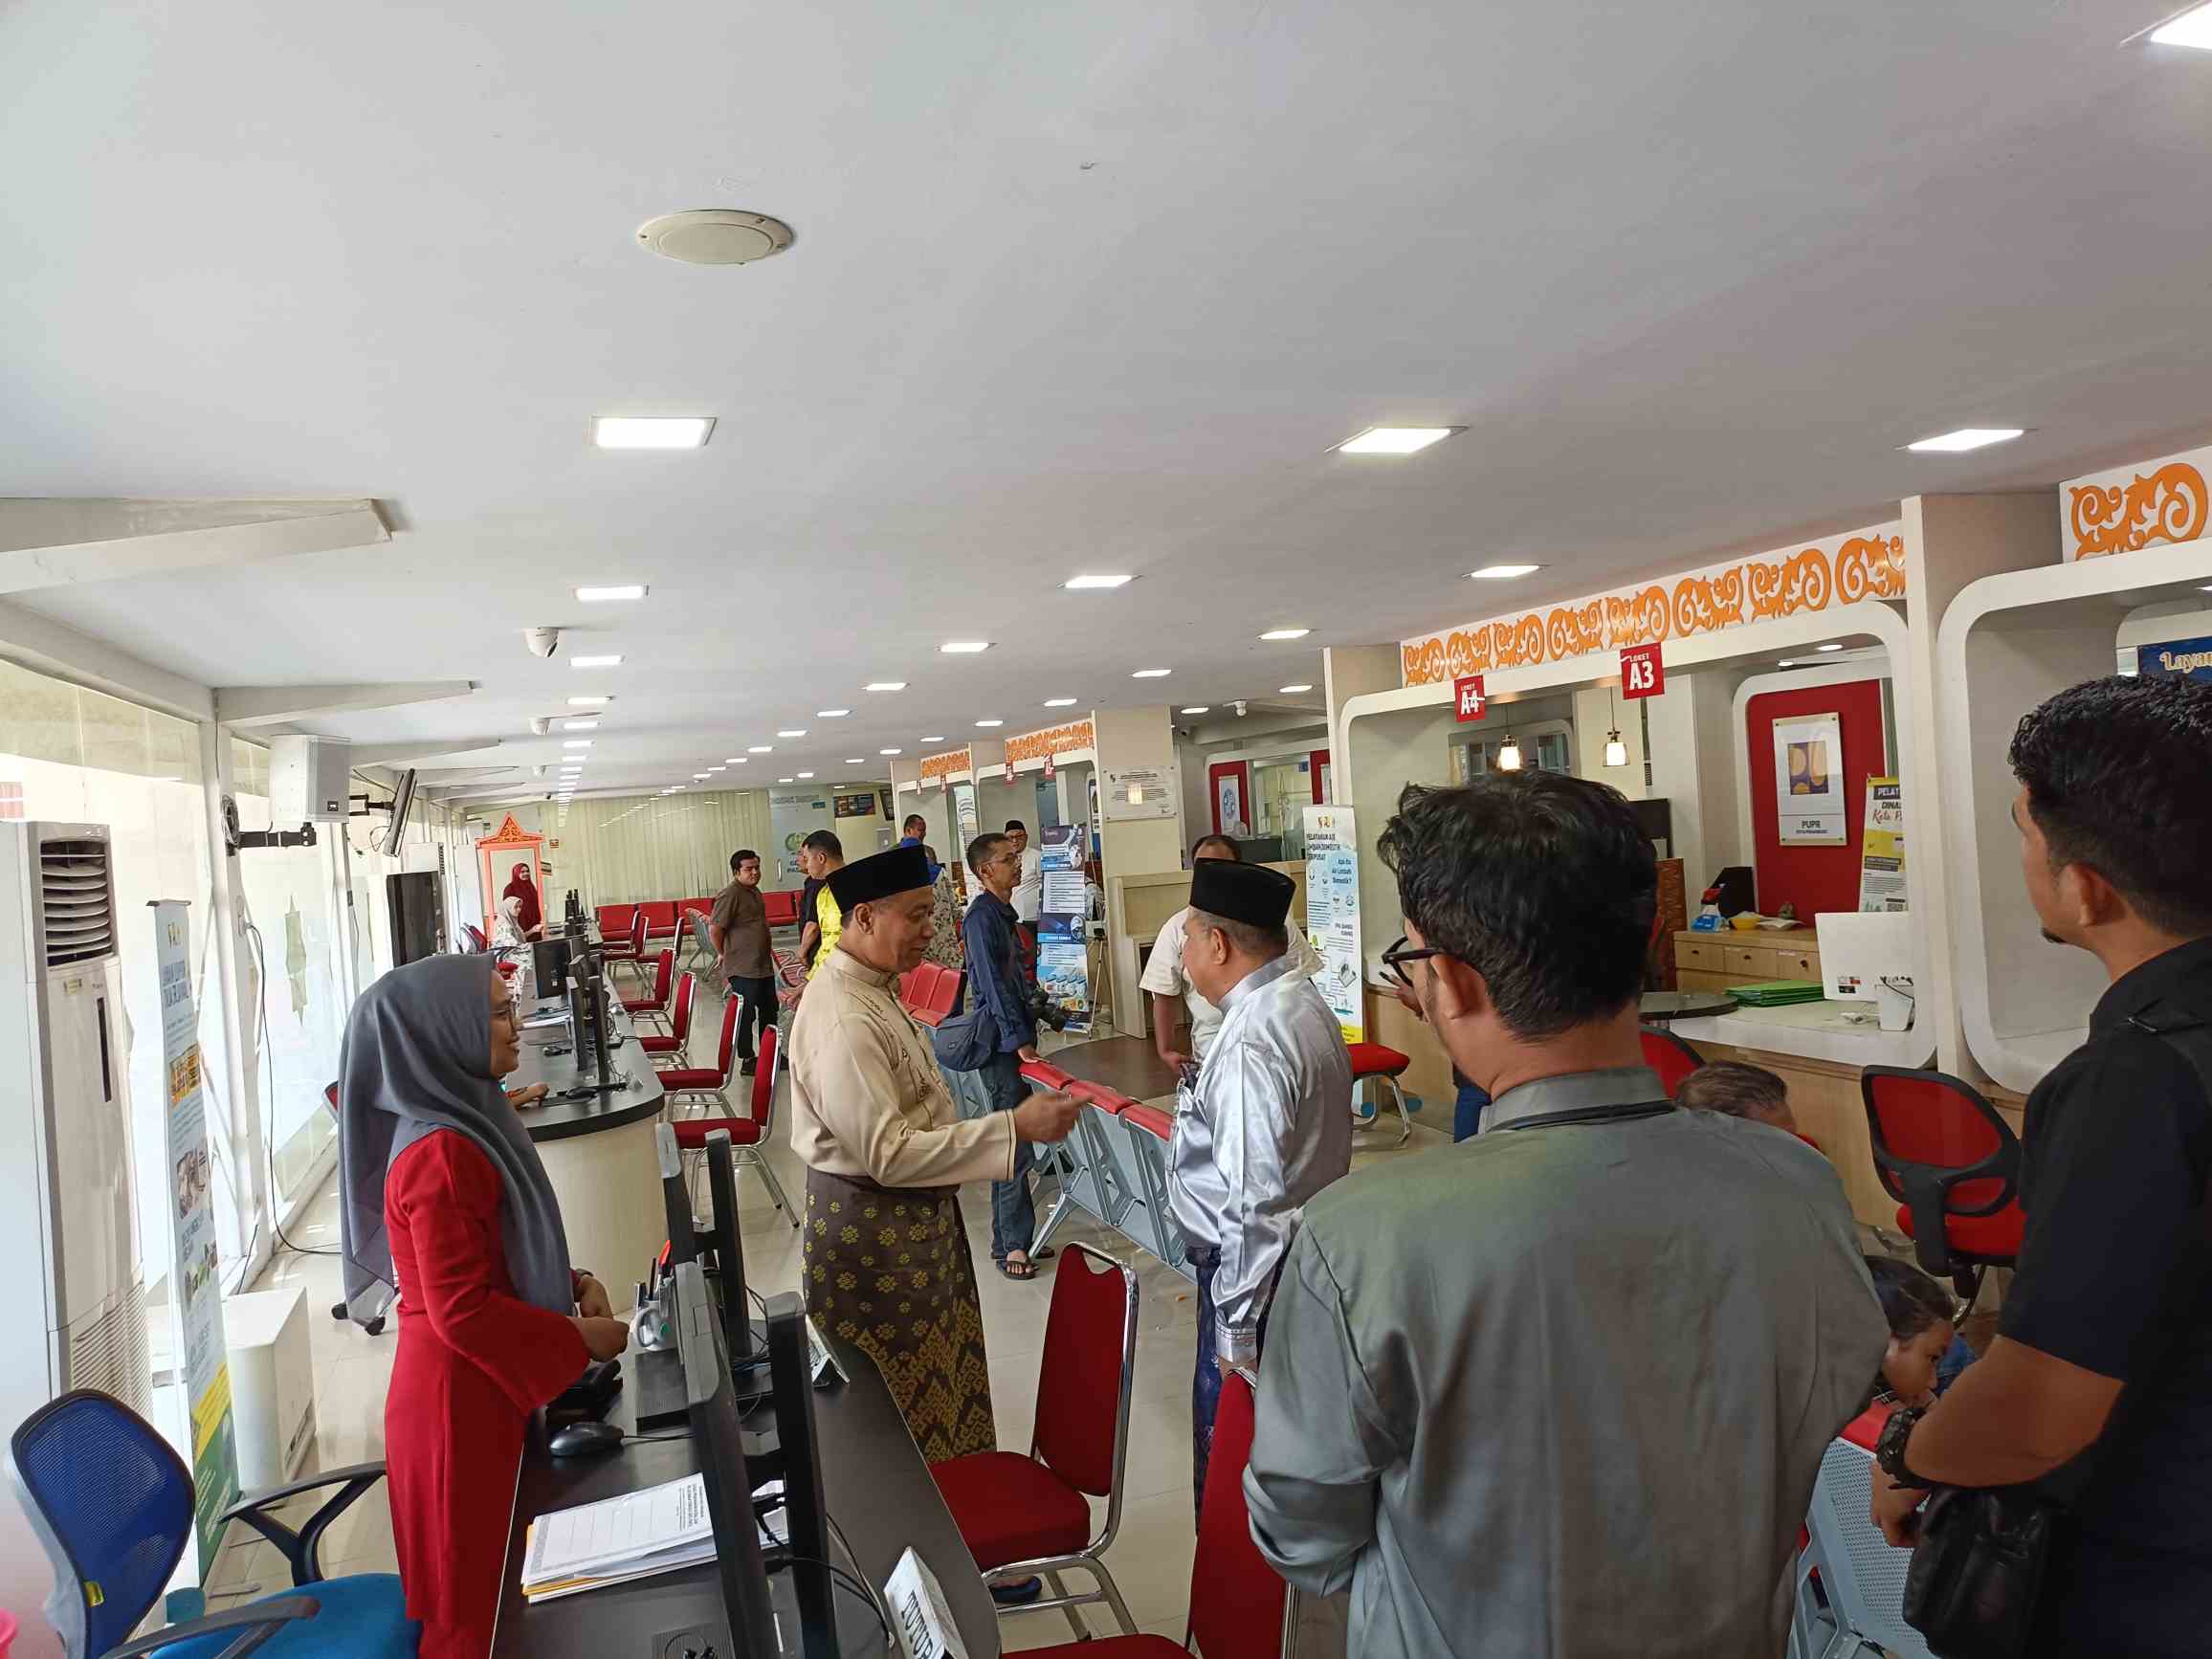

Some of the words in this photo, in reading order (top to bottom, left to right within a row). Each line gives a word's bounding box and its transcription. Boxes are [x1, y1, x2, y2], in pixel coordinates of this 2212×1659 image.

[1629, 653, 1649, 662] LOKET
[1629, 661, 1654, 690] A3
[1461, 690, 1479, 715] A4
